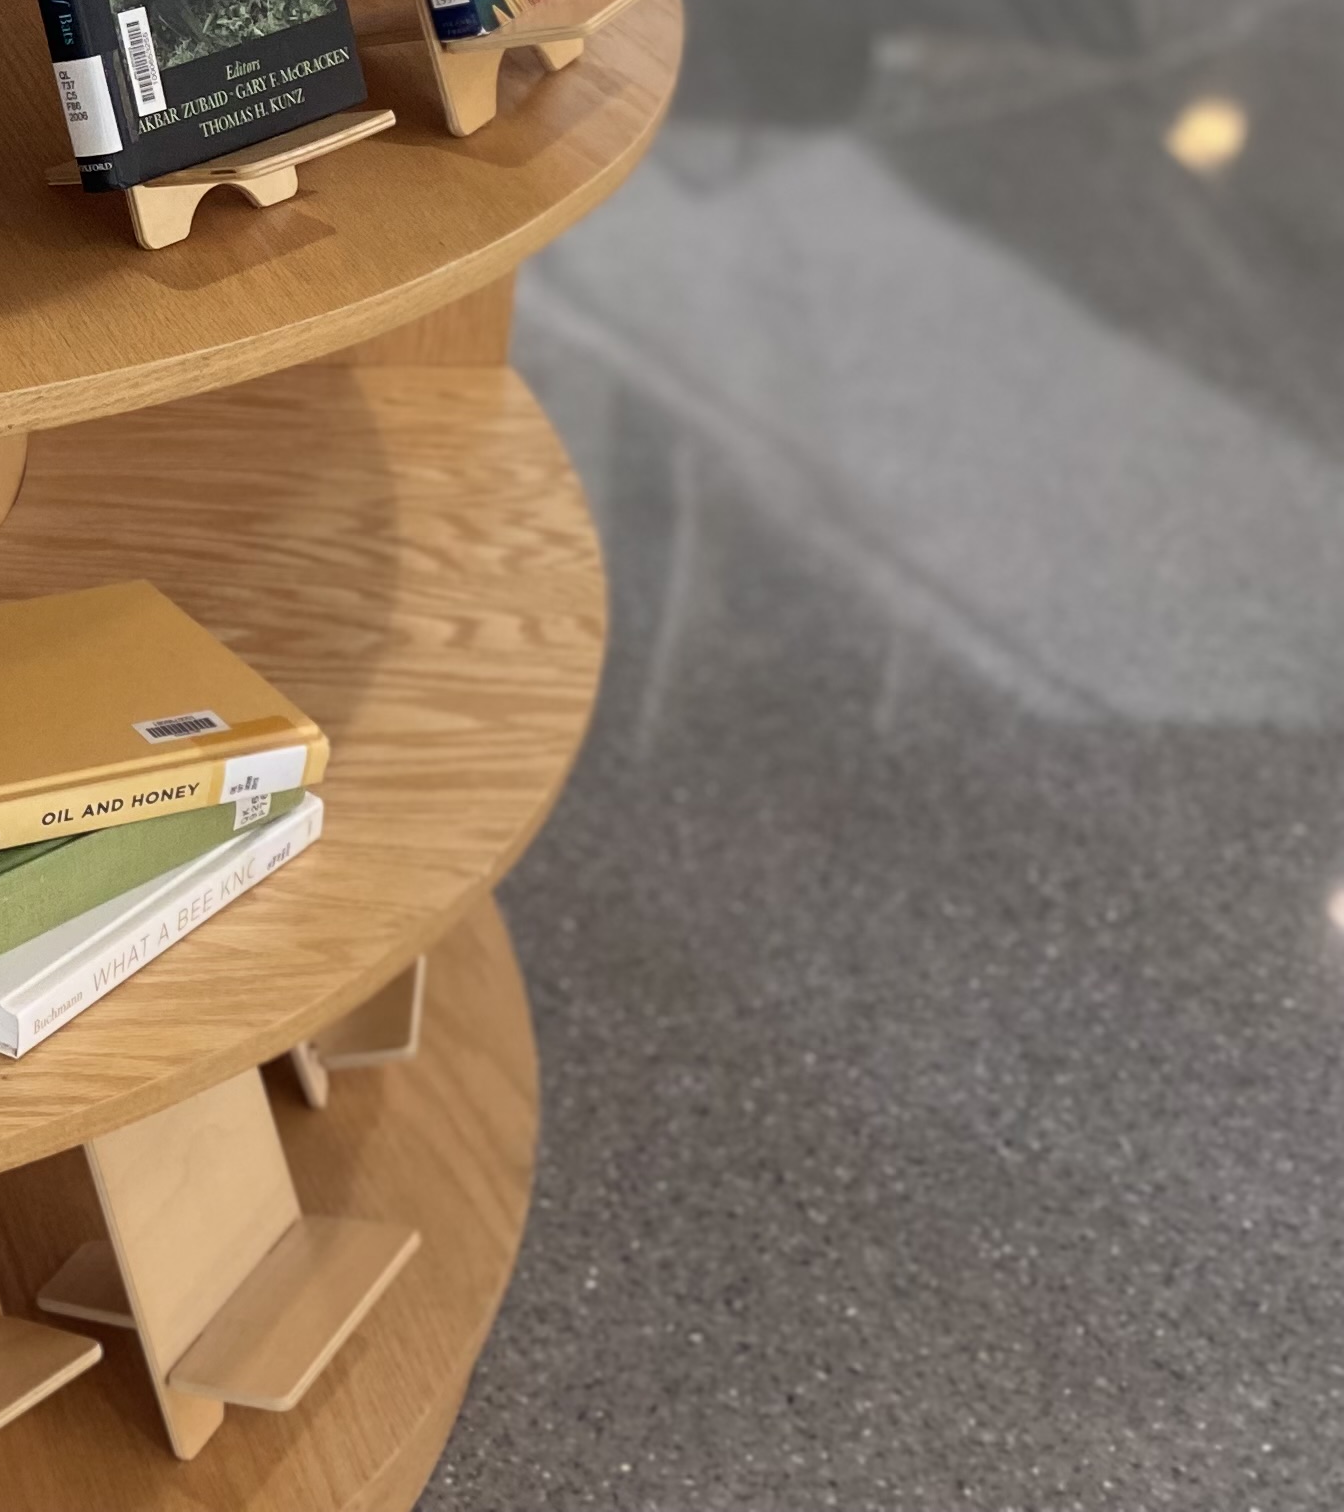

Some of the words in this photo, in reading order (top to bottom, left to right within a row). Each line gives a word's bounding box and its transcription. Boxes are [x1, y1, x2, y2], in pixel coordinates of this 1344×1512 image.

[138, 108, 180, 135] AKBAR
[181, 93, 229, 118] ZUBAID
[235, 75, 268, 100] GARY
[270, 72, 280, 88] F.
[281, 47, 350, 83] McCRACKEN
[226, 59, 261, 81] Editors
[199, 105, 254, 139] THOMAS
[255, 102, 269, 118] H.
[269, 87, 306, 113] KUNZ
[42, 808, 73, 826] OIL
[82, 799, 124, 817] AND
[131, 782, 200, 808] HONEY
[34, 991, 83, 1034] Buchmann
[93, 935, 149, 991] WHAT
[158, 922, 169, 941] A
[178, 890, 213, 931] BEE
